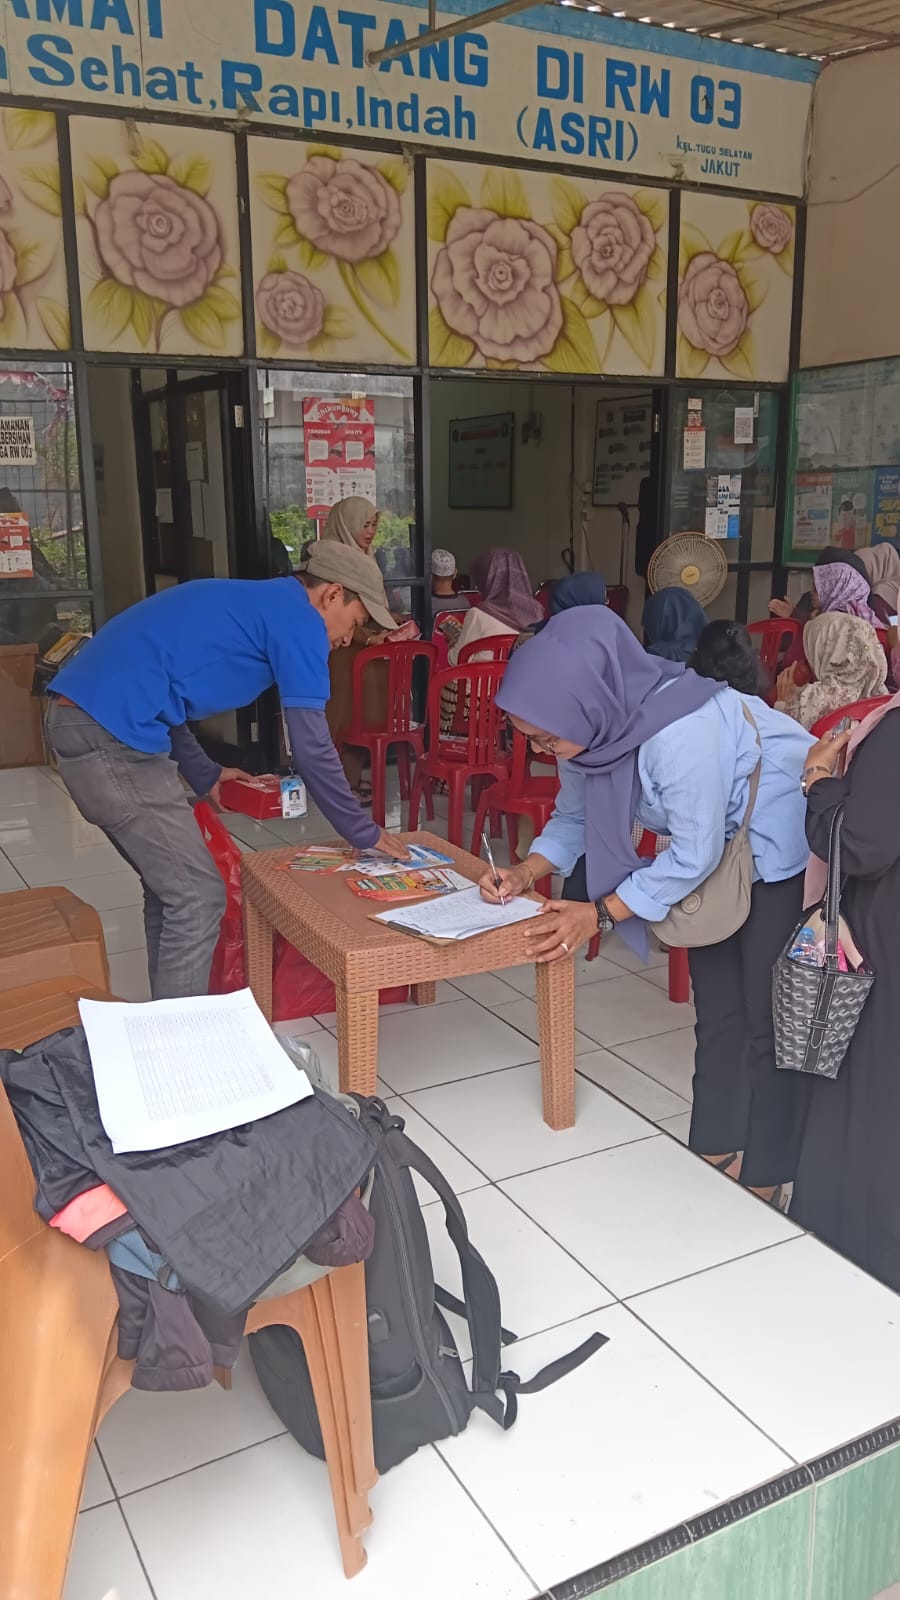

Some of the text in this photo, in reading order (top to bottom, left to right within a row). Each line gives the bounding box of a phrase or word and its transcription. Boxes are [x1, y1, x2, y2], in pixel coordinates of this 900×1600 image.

[254, 0, 489, 88] DATANG
[537, 45, 584, 104] DI
[606, 57, 670, 118] RW
[690, 75, 742, 130] 03
[516, 105, 639, 163] (ASRI)
[719, 146, 753, 161] SELATAN
[701, 158, 741, 177] JAKUT
[0, 431, 31, 445] BERSIHAN
